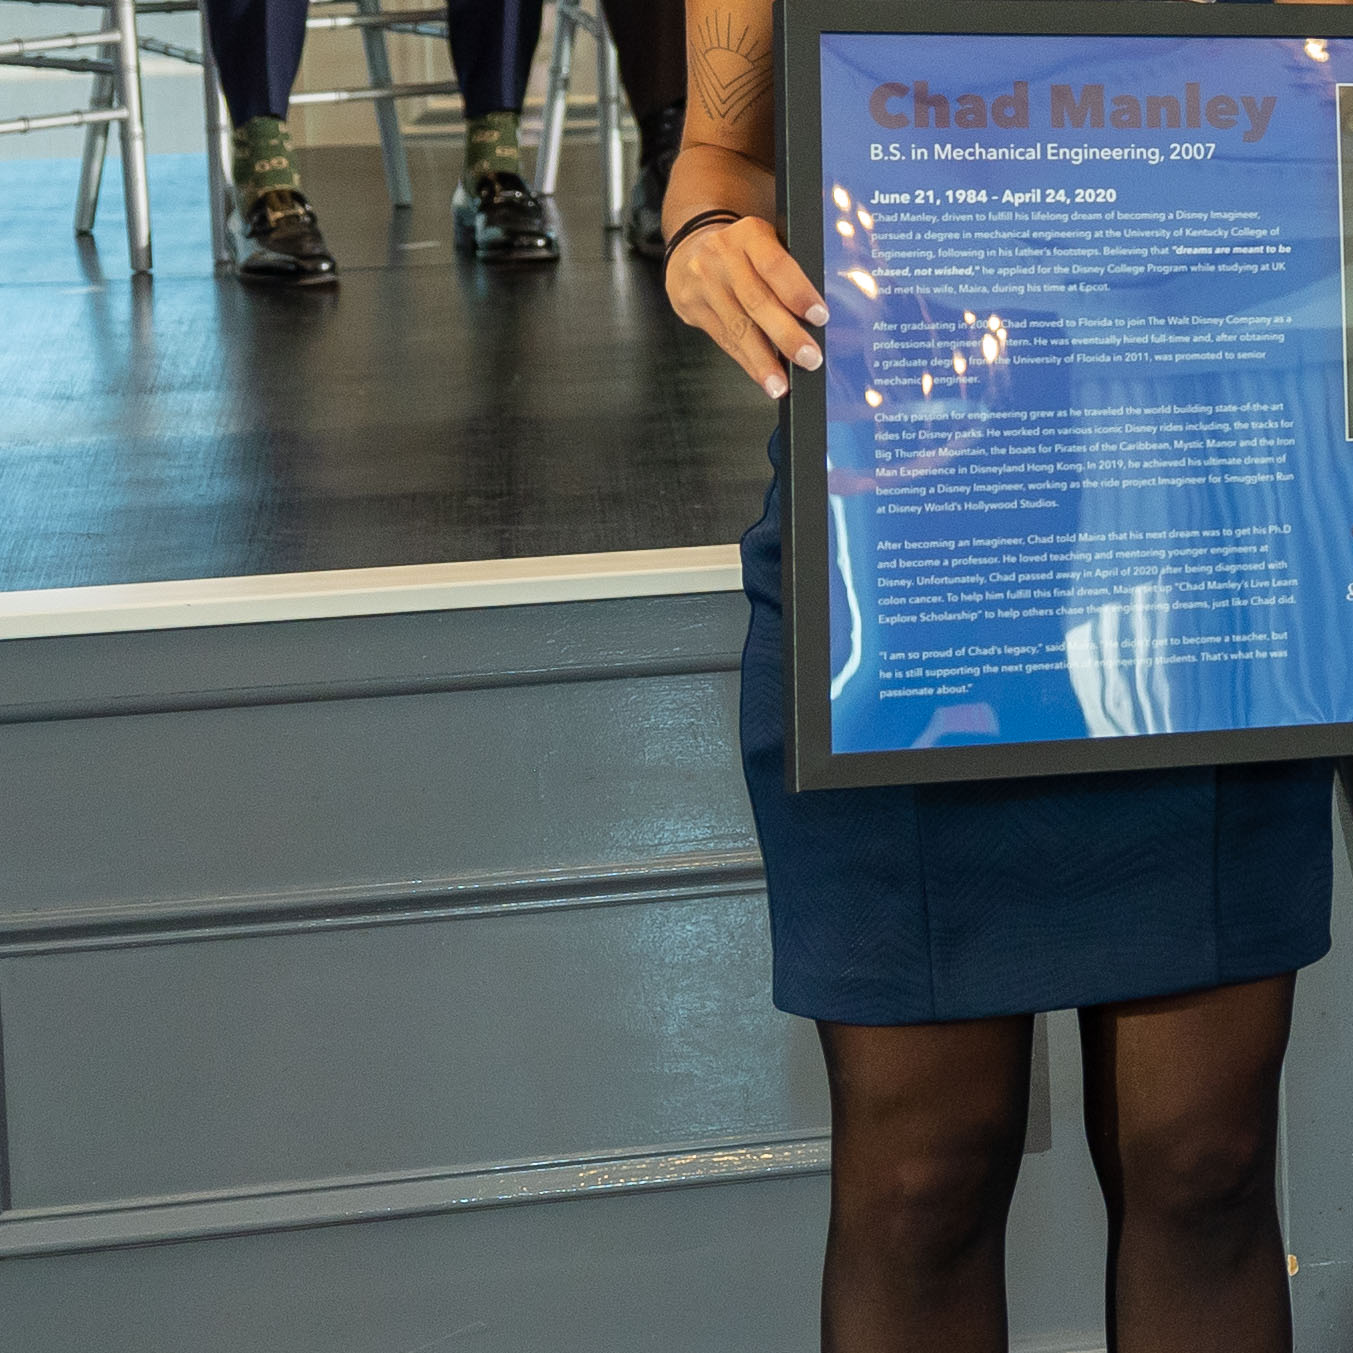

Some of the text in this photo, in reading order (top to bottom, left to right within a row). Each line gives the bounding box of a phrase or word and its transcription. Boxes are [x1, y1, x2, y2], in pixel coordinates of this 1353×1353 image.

[868, 80, 1277, 143] Chad Manley
[871, 143, 1216, 165] B.S. in Mechanical Engineering, 2007
[870, 190, 911, 204] June
[914, 189, 941, 205] 21,
[945, 189, 988, 203] 1984
[1002, 189, 1041, 205] April
[1045, 189, 1071, 204] 24,
[1074, 188, 1117, 203] 2020
[870, 227, 1280, 243] pursued a degree in mechanical engineering at the University of Kentucky College of
